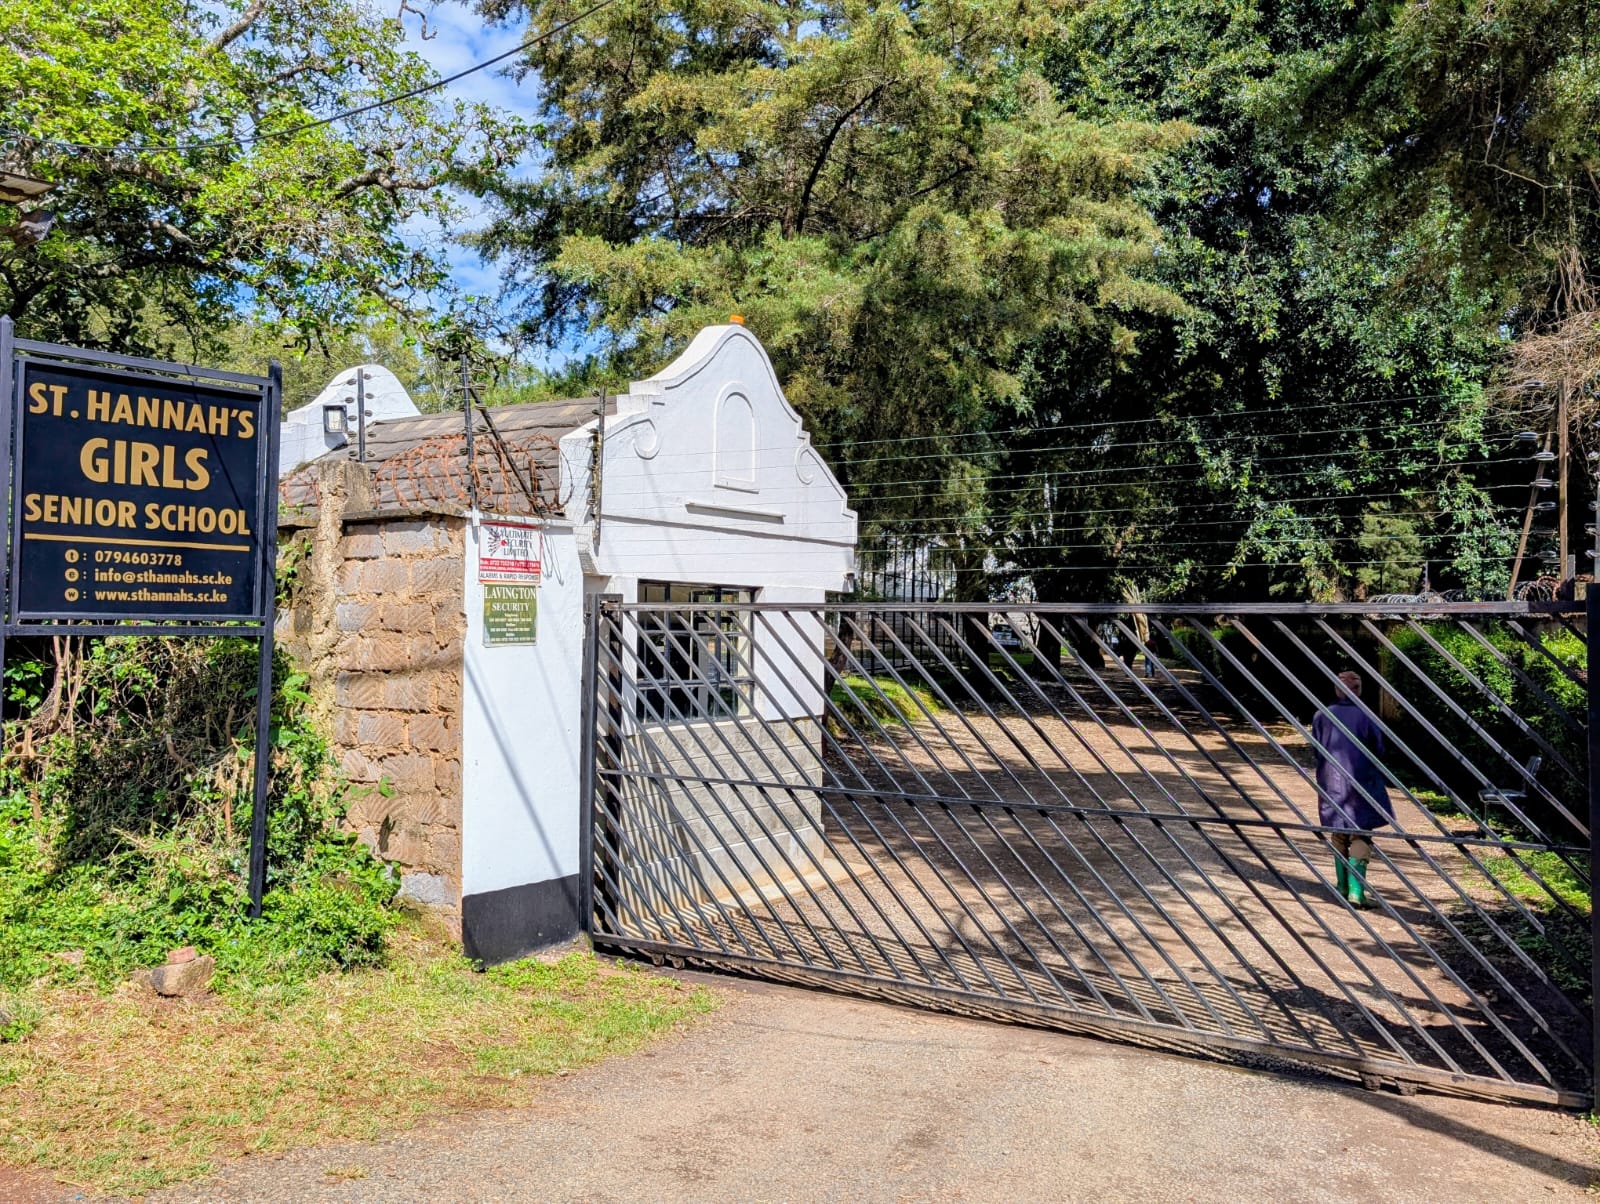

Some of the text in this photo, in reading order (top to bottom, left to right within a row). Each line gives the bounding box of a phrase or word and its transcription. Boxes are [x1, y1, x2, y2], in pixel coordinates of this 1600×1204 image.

[29, 382, 255, 439] ST. HANNAH'S
[79, 437, 210, 491] GIRLS
[24, 493, 251, 535] SENIOR SCHOOL
[94, 551, 183, 566] 0794603778
[503, 548, 529, 557] LIMITED
[94, 568, 233, 585] info@sthannahs.sc.ke
[94, 588, 228, 602] www.sthannahs.sc.ke
[484, 587, 537, 600] LAVINGTON
[492, 602, 530, 612] SECURITY
